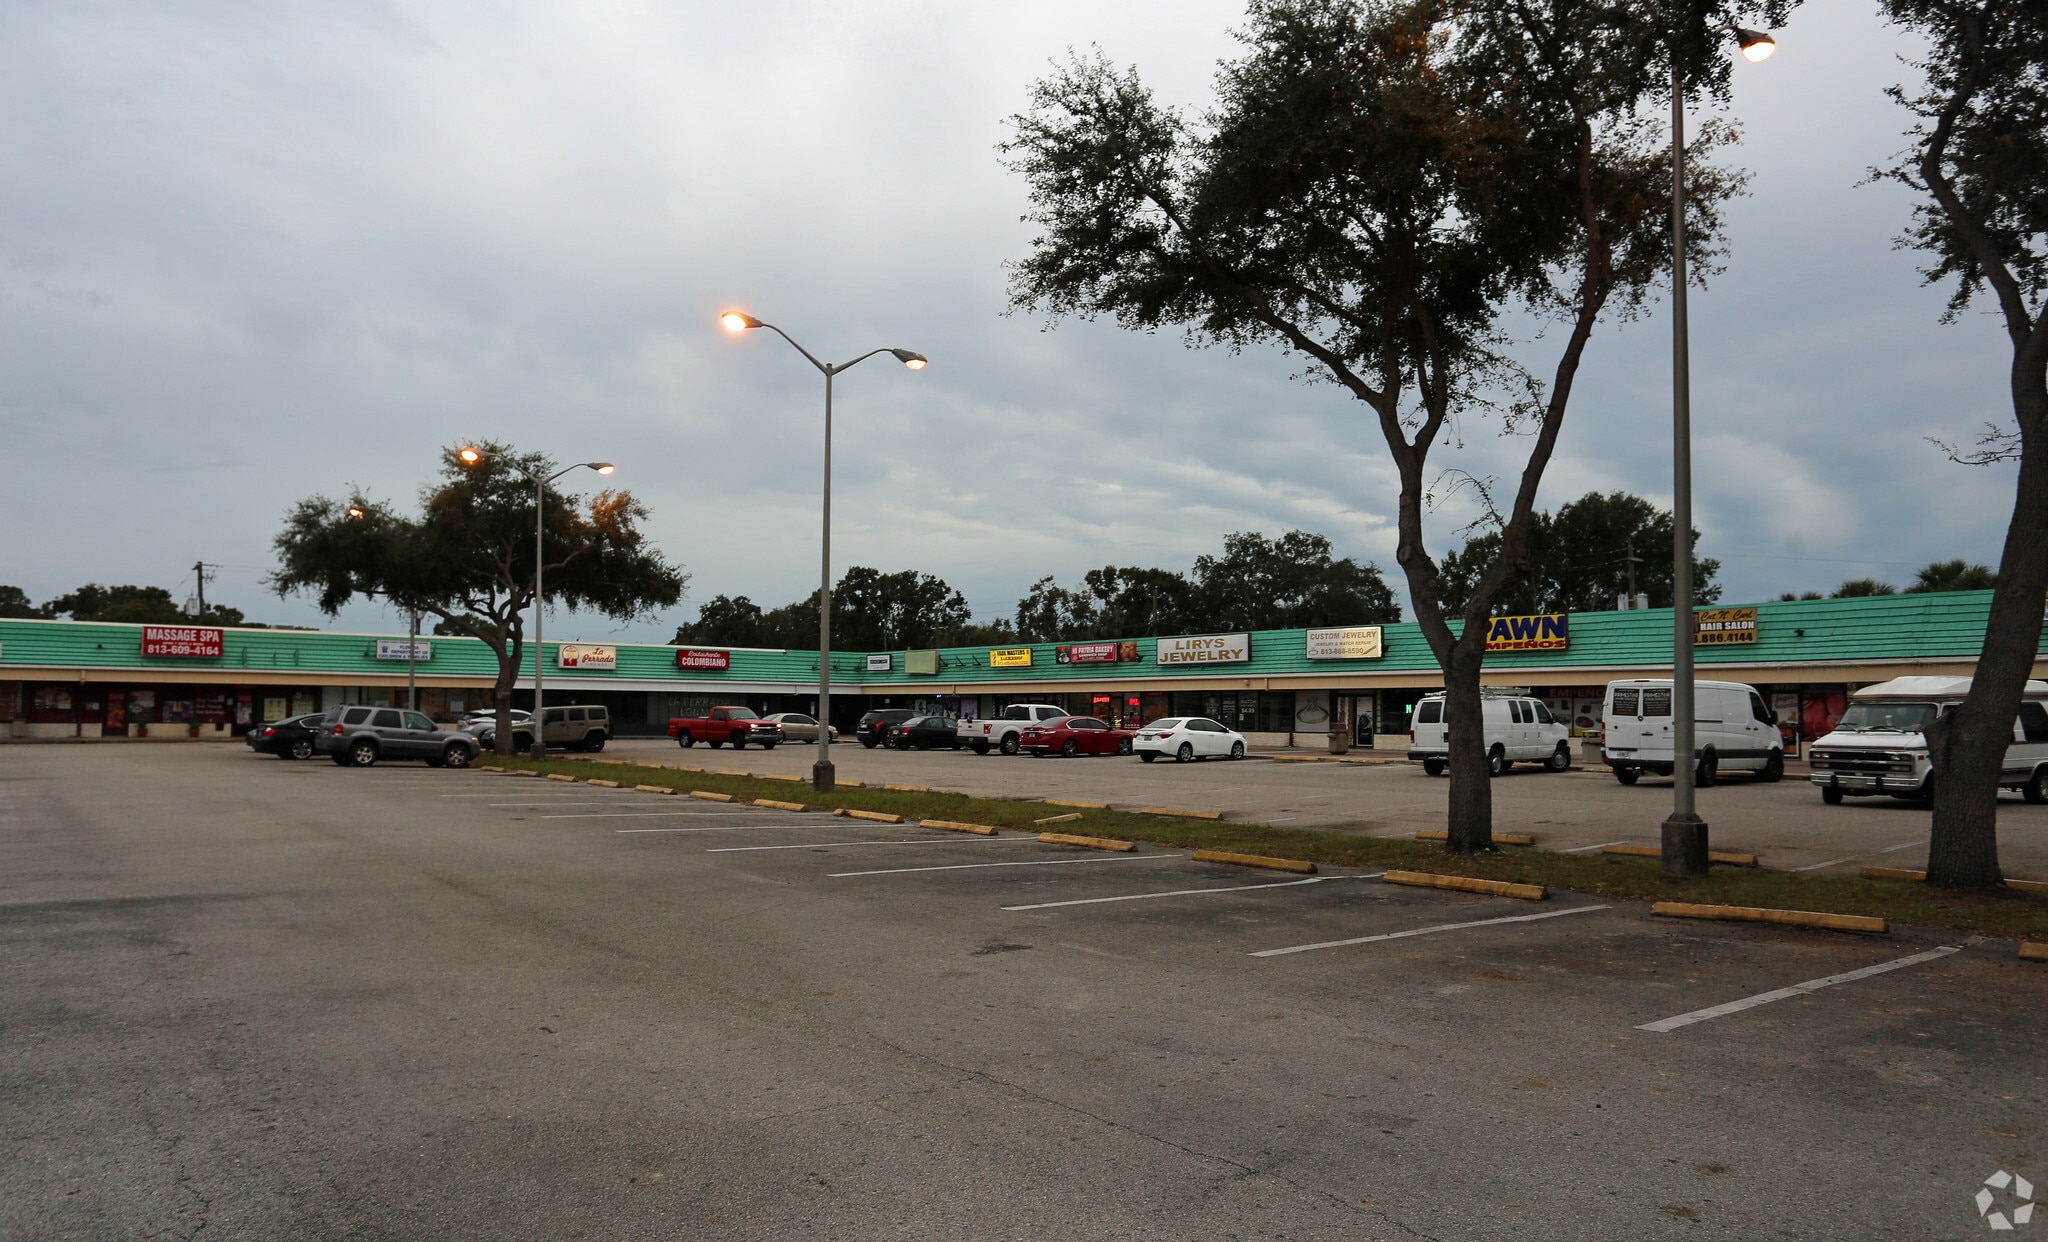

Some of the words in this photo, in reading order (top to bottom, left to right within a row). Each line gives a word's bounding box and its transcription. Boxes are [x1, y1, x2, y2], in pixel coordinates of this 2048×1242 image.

[1700, 622, 1723, 631] HAIR
[1724, 621, 1754, 630] SALON
[147, 629, 197, 641] MASSAGE
[200, 630, 219, 642] SPA
[1342, 631, 1377, 639] JEWELRY
[1095, 645, 1113, 653] BAKERY
[1175, 638, 1225, 650] LIRYS
[1485, 640, 1566, 650] MPEÑOS
[148, 644, 219, 655] 813-609-4164
[593, 647, 604, 655] La
[582, 653, 614, 663] Perrada
[1160, 649, 1243, 662] JEWELRY
[682, 657, 726, 667] COLOMBIANO
[1550, 687, 1607, 697] EMPEÑO
